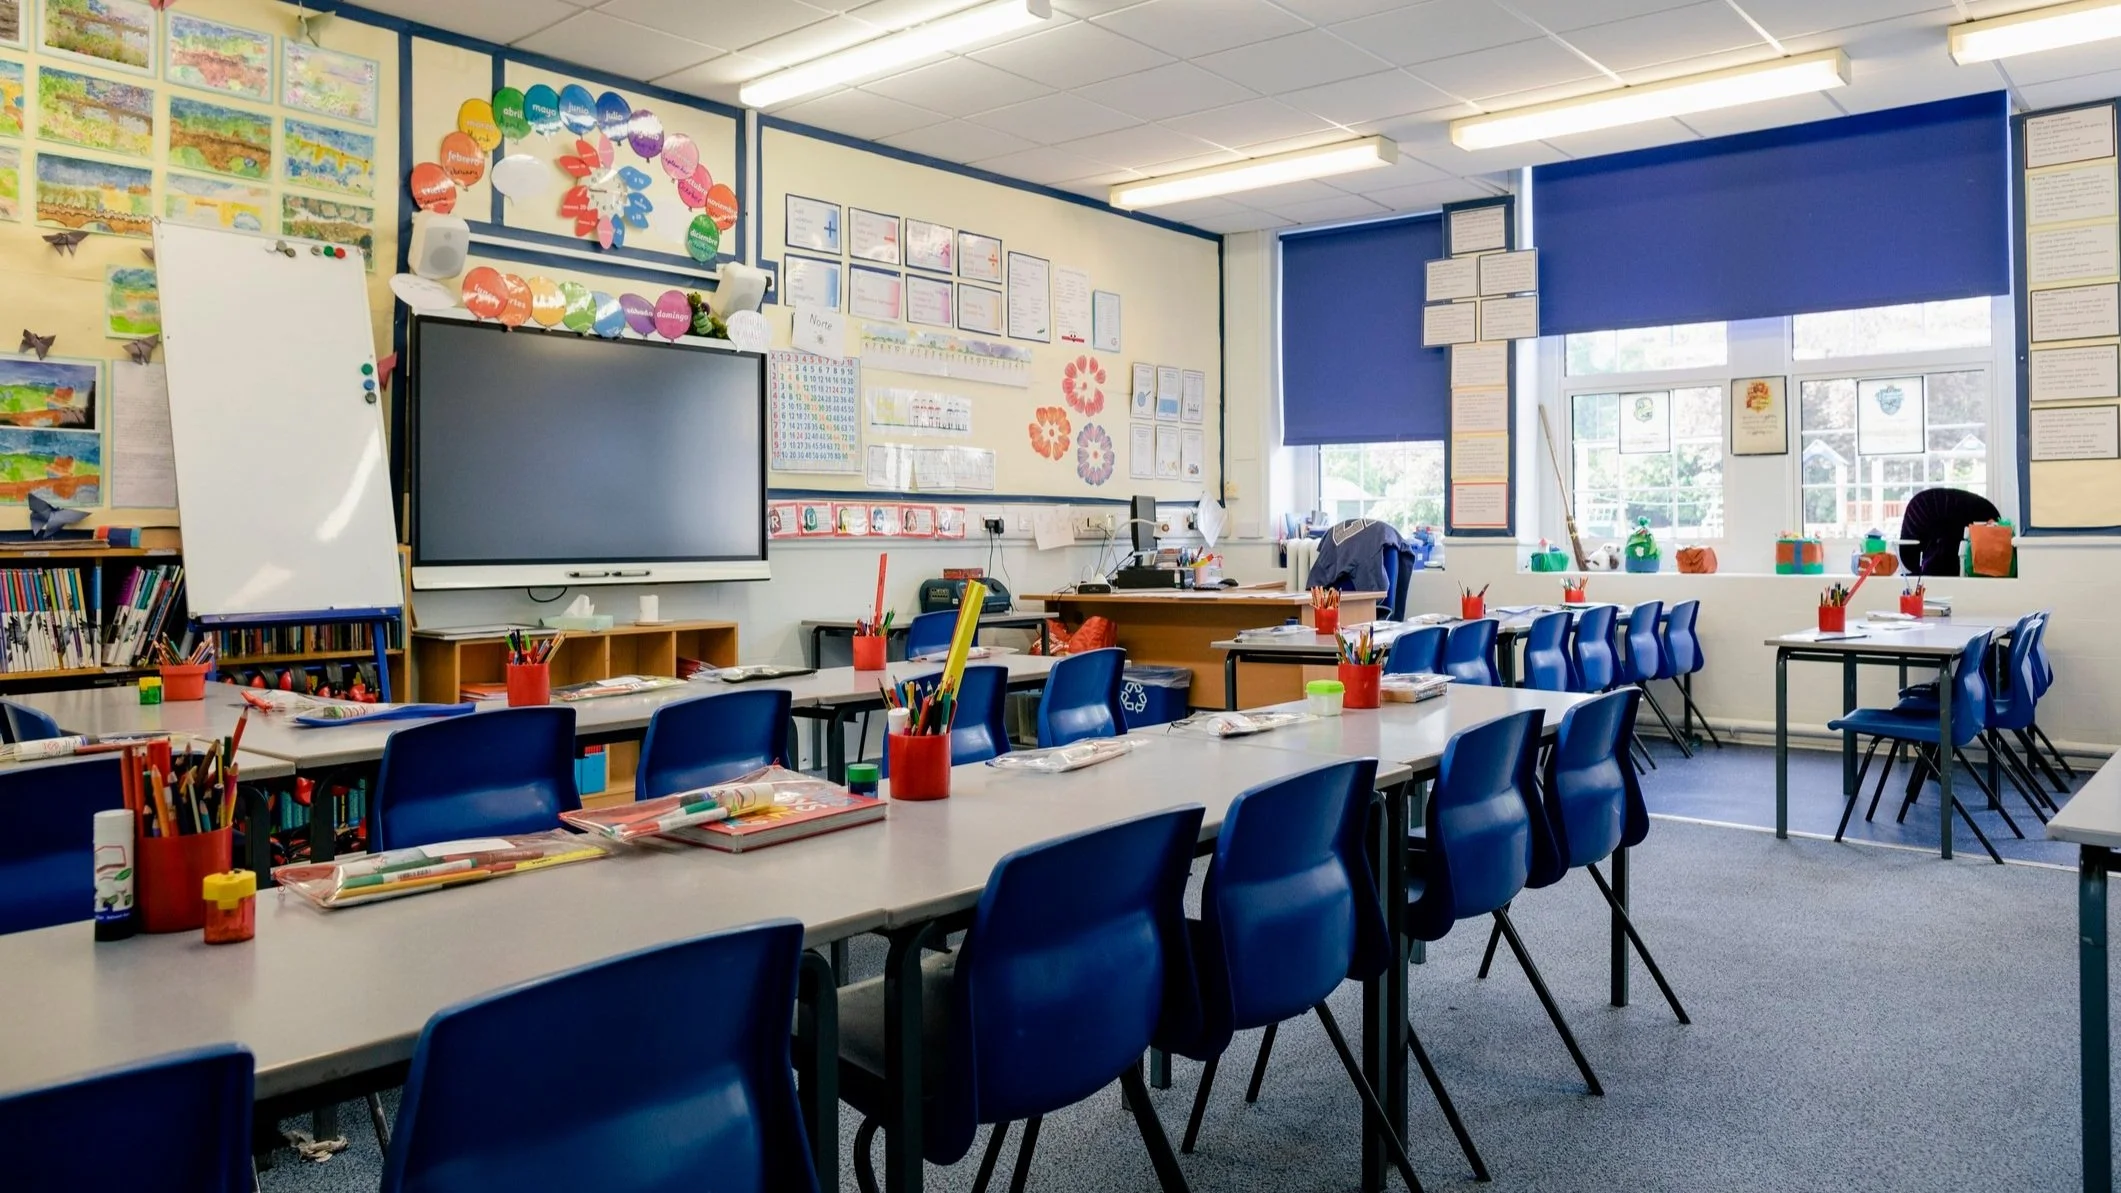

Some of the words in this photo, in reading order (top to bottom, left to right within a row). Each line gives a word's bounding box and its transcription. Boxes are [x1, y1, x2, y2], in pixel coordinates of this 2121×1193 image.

[503, 107, 523, 119] abril
[532, 103, 557, 117] mayo
[568, 102, 589, 116] junio
[605, 110, 624, 122] julio
[447, 150, 480, 166] febrero
[690, 229, 718, 245] diciembre
[656, 309, 689, 322] domingo
[809, 313, 833, 331] Norte
[770, 518, 780, 528] R
[806, 516, 817, 526] U
